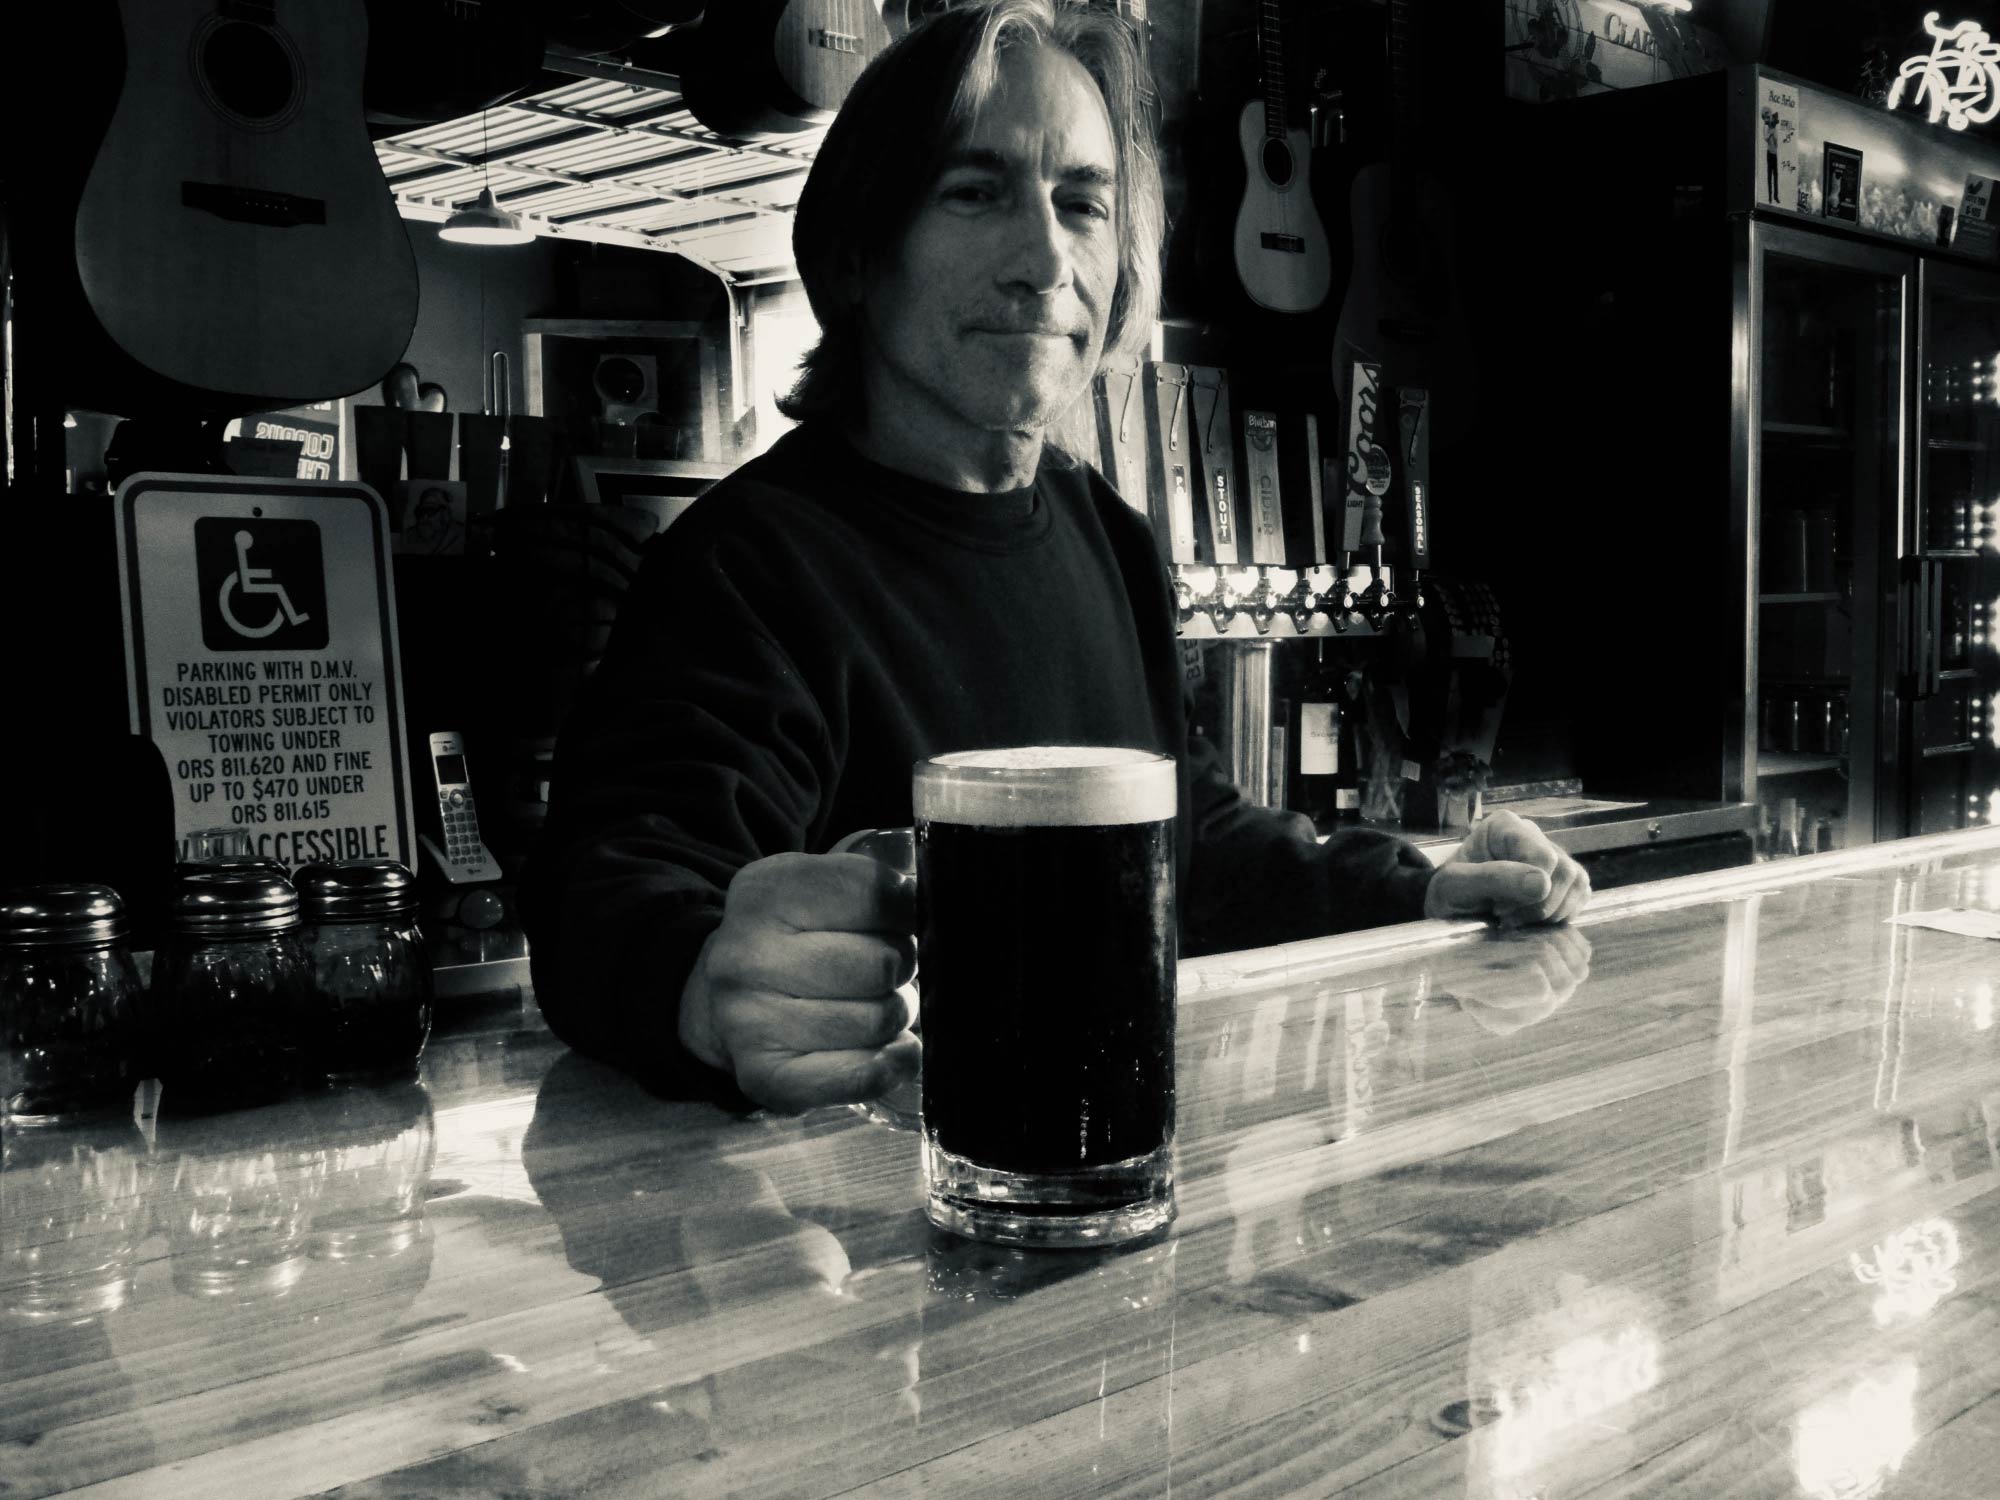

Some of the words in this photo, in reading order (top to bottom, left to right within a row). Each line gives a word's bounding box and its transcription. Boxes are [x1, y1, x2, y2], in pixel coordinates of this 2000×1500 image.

[1217, 476, 1228, 537] STOUT
[1260, 475, 1273, 536] CIDER
[1347, 500, 1364, 508] LIGHT
[1414, 487, 1424, 549] SEASONAL
[178, 662, 256, 681] PARKING
[263, 661, 303, 679] WITH
[311, 660, 357, 679] D.M.V.
[164, 686, 251, 706] DISABLED
[259, 684, 321, 703] PERMIT
[329, 683, 372, 701] ONLY
[167, 709, 265, 730] VIOLATORS
[273, 707, 347, 727] SUBJECT
[354, 705, 374, 723] TO
[208, 733, 274, 753] TOWING
[282, 730, 340, 749] UNDER
[178, 759, 214, 779] ORS
[222, 755, 284, 776] 811.620
[293, 754, 326, 773] AND
[334, 752, 371, 770] FINE
[190, 783, 214, 802] UP
[222, 781, 244, 800] TO
[253, 779, 298, 801] $470
[307, 775, 363, 795] UNDER
[232, 804, 266, 824] ORS
[274, 800, 329, 821] 811.615
[243, 825, 391, 865] ACCESSIBLE
